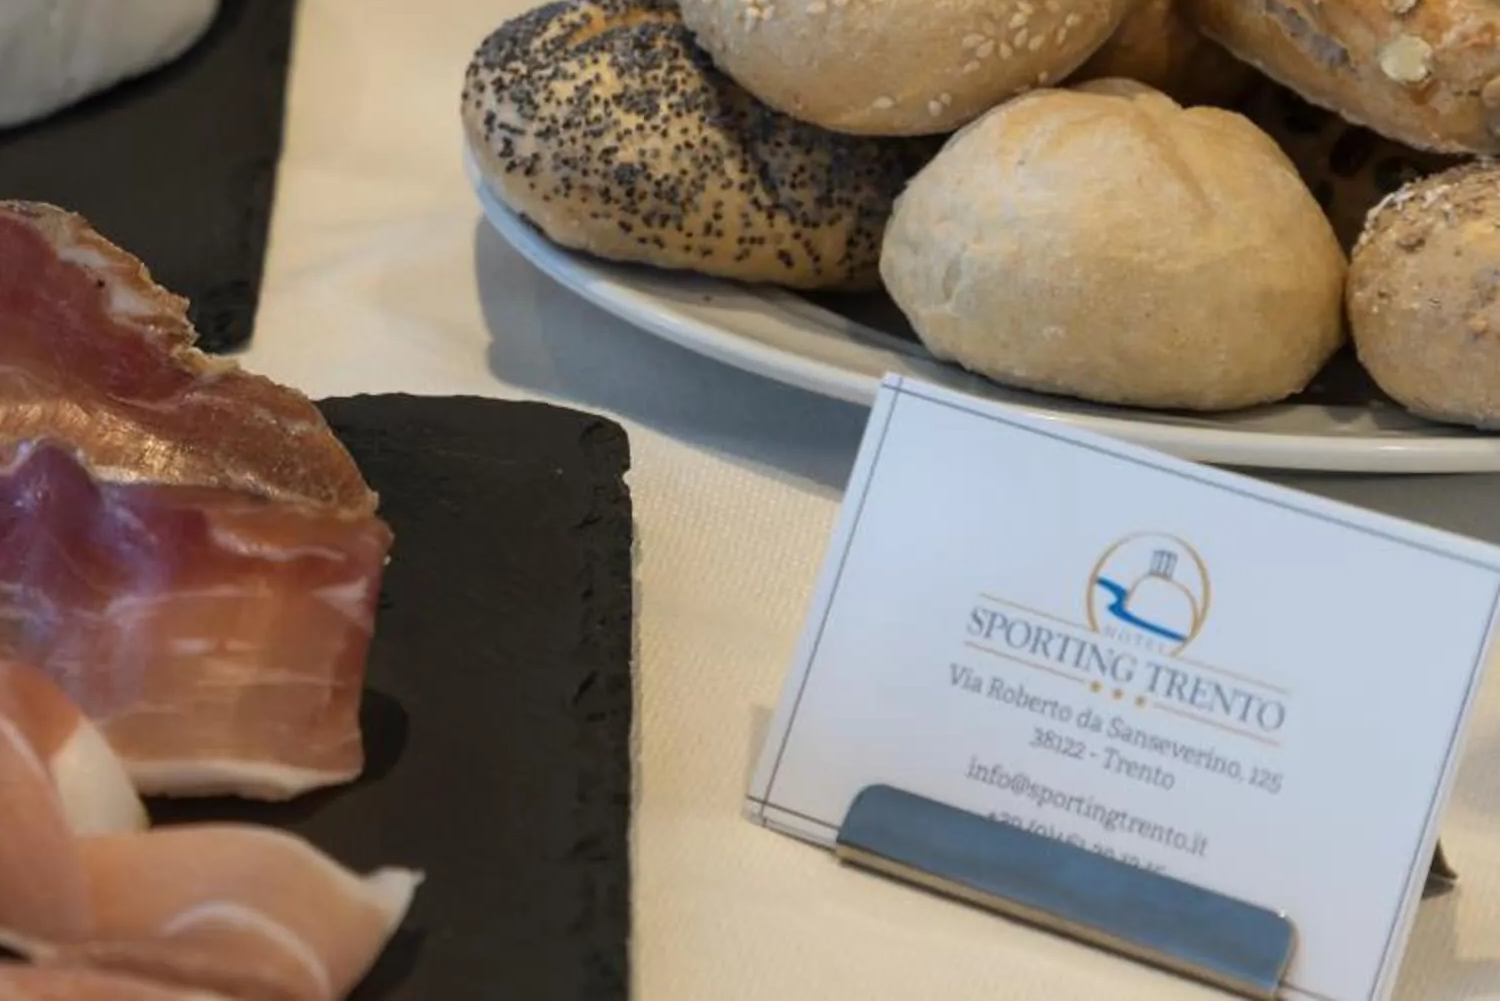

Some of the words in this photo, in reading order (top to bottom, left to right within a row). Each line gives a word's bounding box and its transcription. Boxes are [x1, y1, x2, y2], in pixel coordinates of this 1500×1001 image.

[965, 603, 1138, 685] SPORTING
[1146, 660, 1287, 733] TRENTO
[949, 663, 983, 695] Via
[987, 676, 1073, 722] Roberto
[1076, 703, 1104, 734] da
[1106, 715, 1245, 783] Sanseverino,
[1247, 764, 1285, 796] 125
[1028, 727, 1088, 761] 38122
[1102, 746, 1177, 791] Trento
[963, 753, 1209, 858] info@sportingtrento.it
